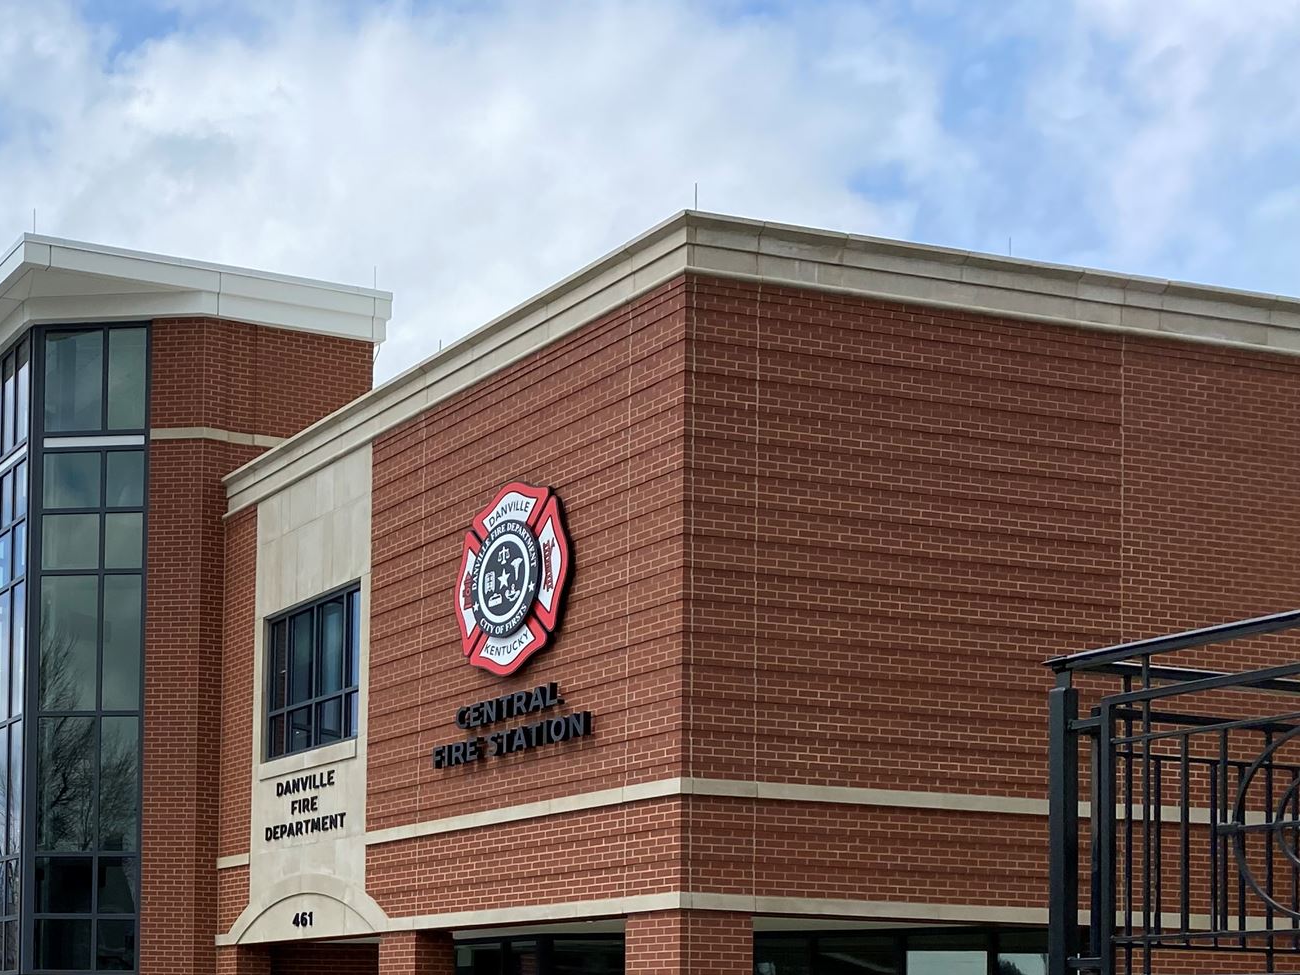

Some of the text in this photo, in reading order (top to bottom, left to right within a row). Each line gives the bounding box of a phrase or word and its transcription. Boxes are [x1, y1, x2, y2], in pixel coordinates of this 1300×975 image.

[488, 500, 531, 528] DANVILLE
[471, 522, 538, 591] DANVILLE FIRE DEPARTMENT
[479, 603, 528, 635] CITY OF FIRSTS
[484, 630, 529, 657] KENTUCKY
[456, 682, 560, 729] CENTRAL
[432, 711, 589, 769] FIRE STATION
[276, 769, 336, 797] DANVILLE
[290, 795, 319, 816] FIRE
[265, 812, 347, 842] DEPARTMENT
[292, 911, 314, 927] 461
